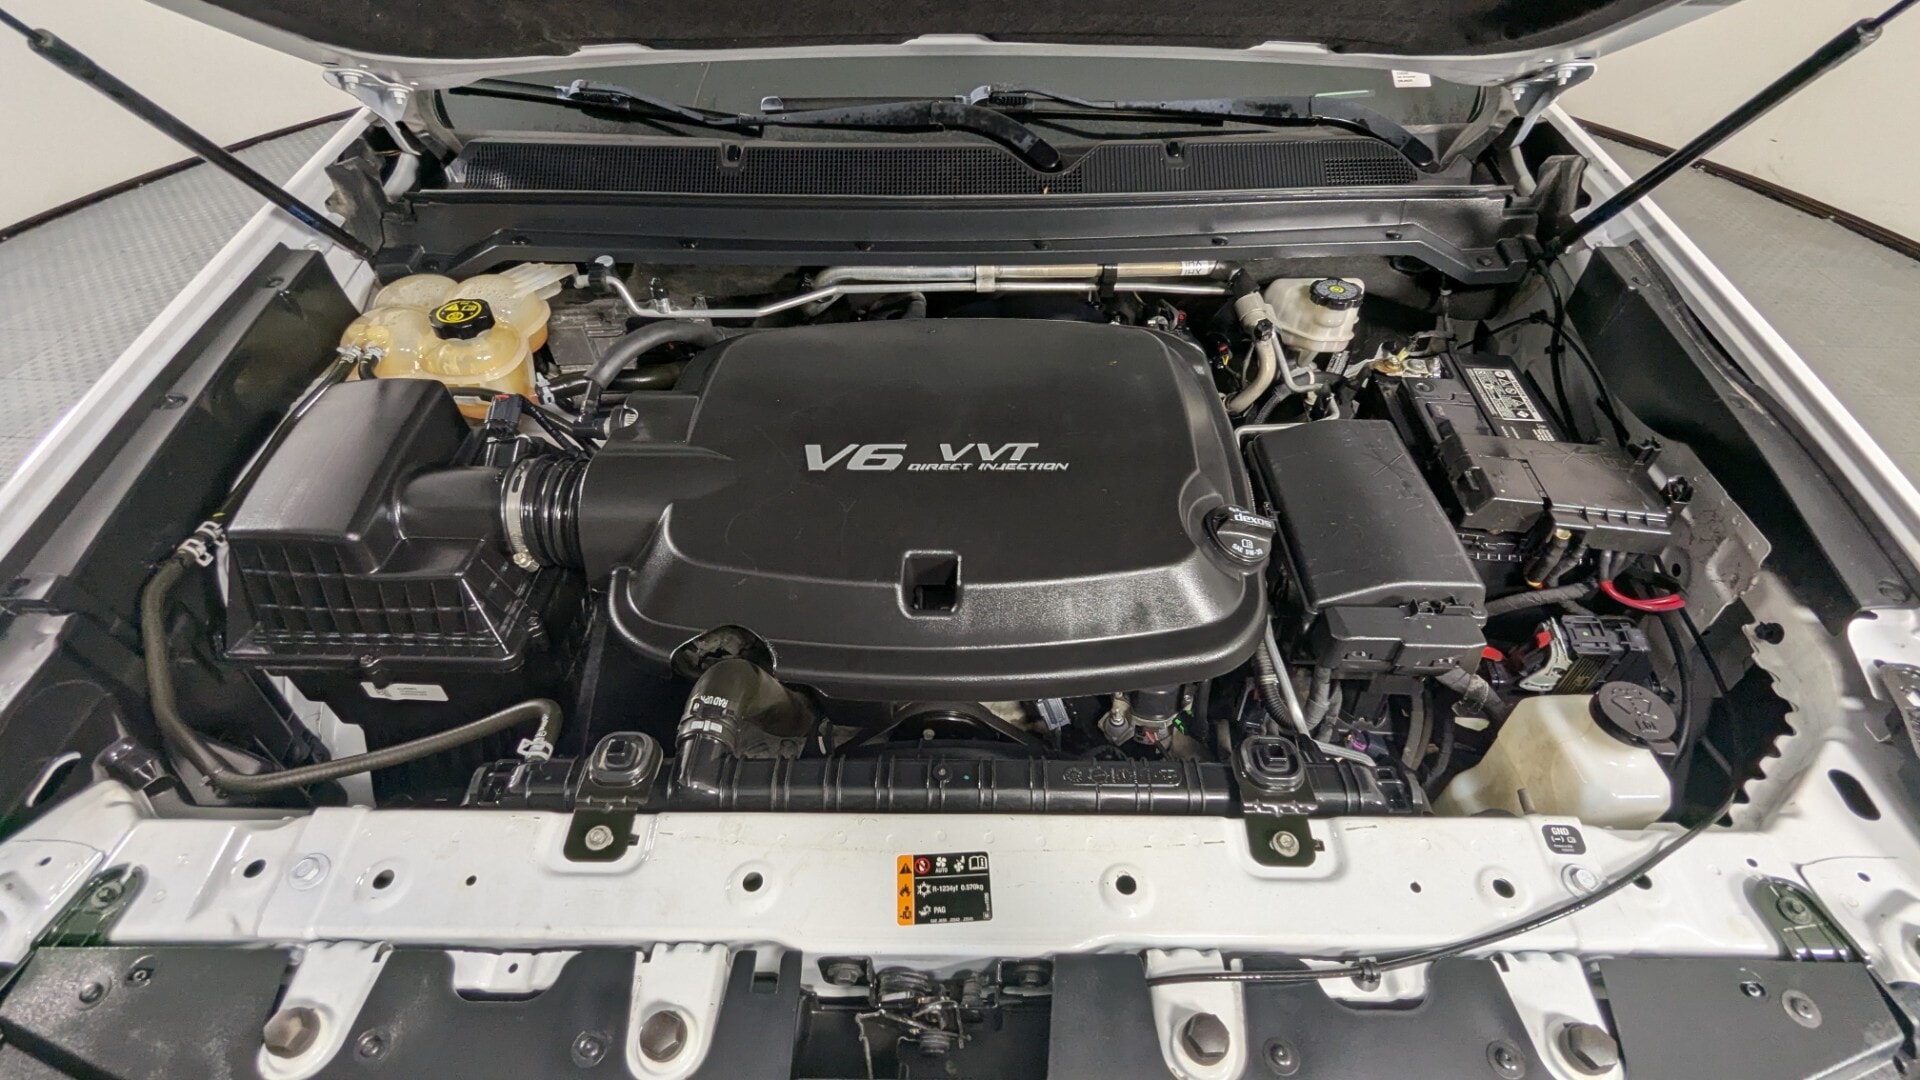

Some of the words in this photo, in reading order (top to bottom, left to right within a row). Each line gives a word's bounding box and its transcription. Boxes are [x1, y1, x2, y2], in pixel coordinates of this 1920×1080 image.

[804, 443, 908, 472] V6
[939, 442, 1040, 462] VVT
[907, 462, 974, 472] DIRECT
[978, 462, 1070, 472] INJECTION
[1233, 512, 1272, 528] dexos
[1551, 827, 1570, 836] GND
[933, 906, 947, 914] PAG
